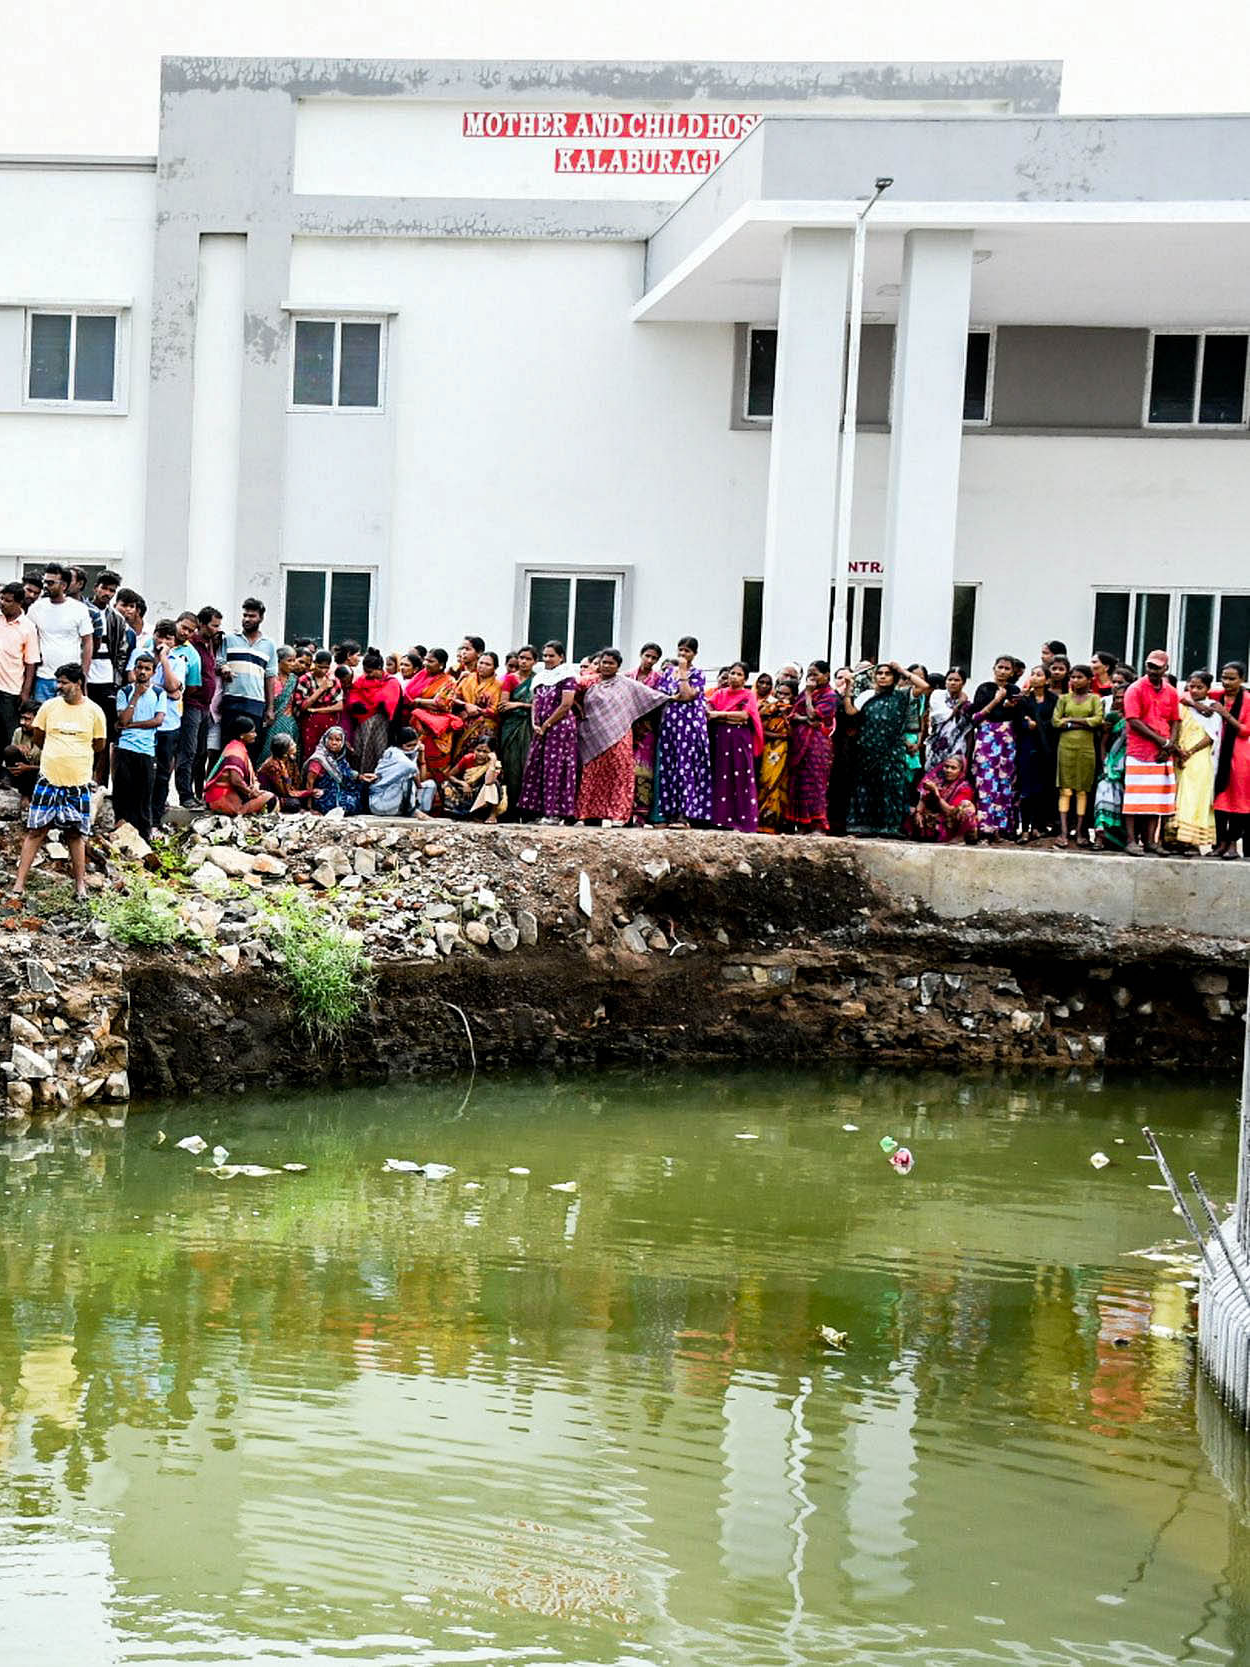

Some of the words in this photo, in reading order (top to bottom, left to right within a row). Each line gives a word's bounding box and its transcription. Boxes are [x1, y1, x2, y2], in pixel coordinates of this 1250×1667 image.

[465, 112, 567, 136] MOTHER
[573, 113, 623, 137] AND
[629, 113, 703, 138] CHILD
[706, 114, 761, 138] HOS
[848, 561, 884, 573] NTR
